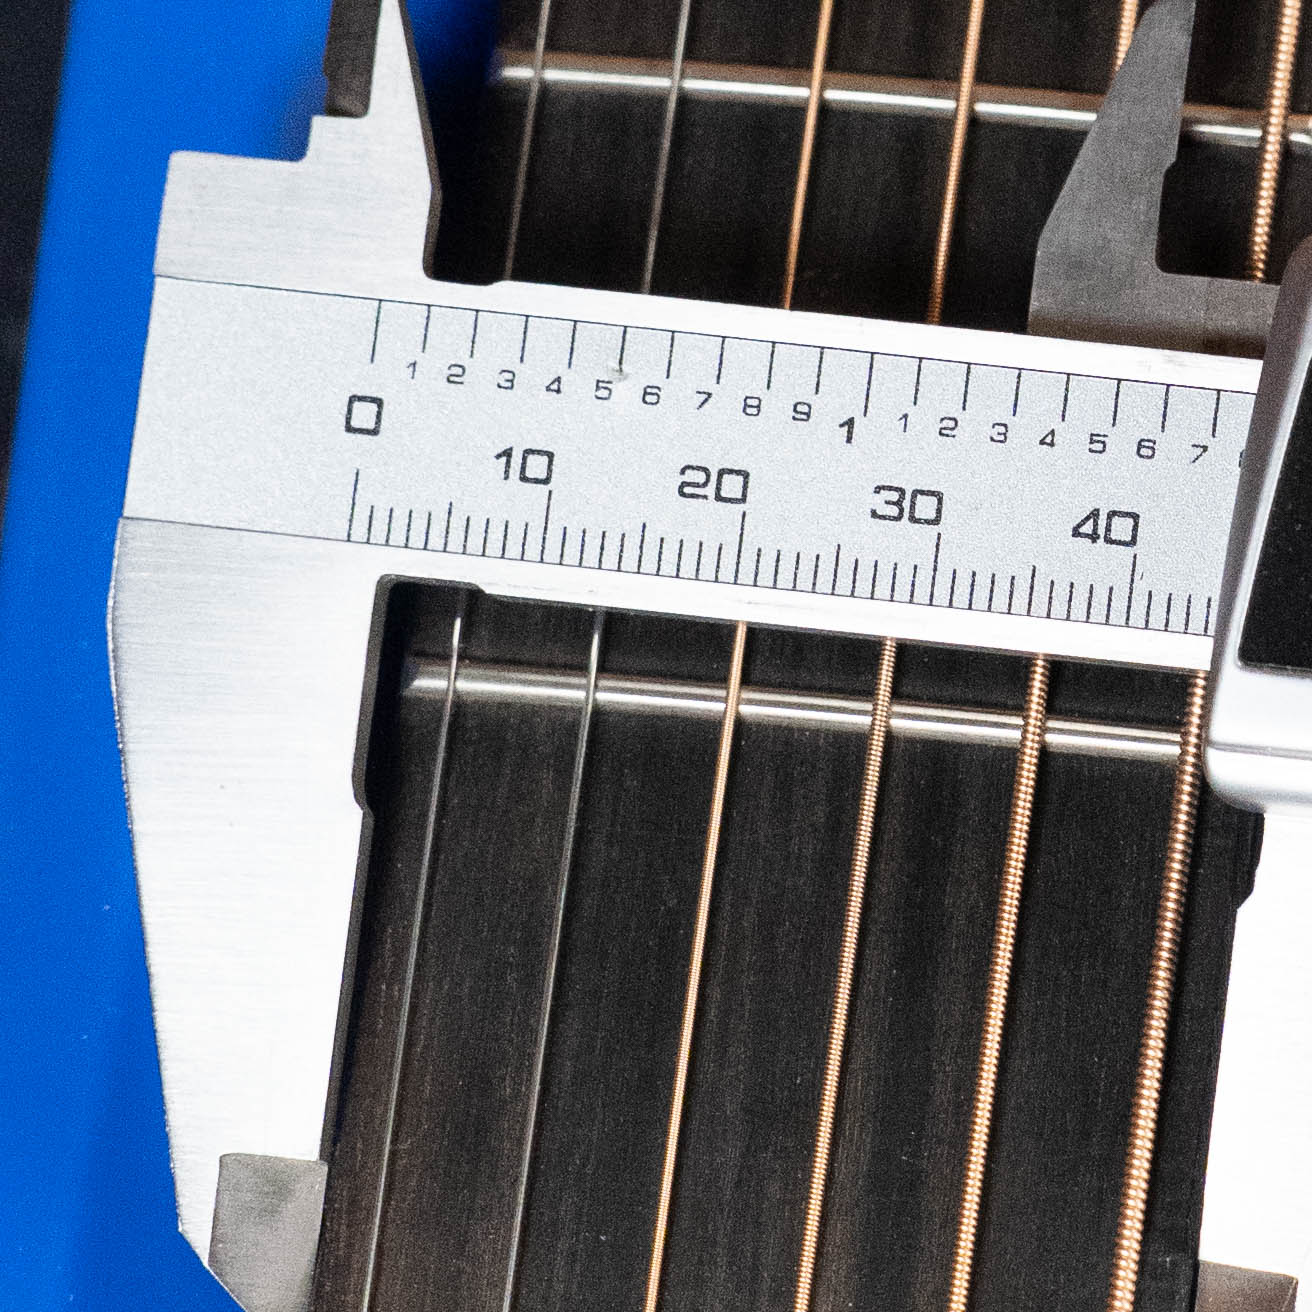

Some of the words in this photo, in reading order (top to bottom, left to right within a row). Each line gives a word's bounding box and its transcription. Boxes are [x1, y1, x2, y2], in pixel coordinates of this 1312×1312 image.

[345, 395, 384, 436] 0
[495, 447, 554, 485] 10
[678, 465, 750, 504] 20
[871, 485, 943, 526] 30
[1072, 508, 1140, 547] 40
[407, 361, 417, 379] 1
[446, 364, 466, 385] 2
[497, 370, 516, 390] 3
[546, 376, 561, 394] 4
[595, 379, 613, 400] 5
[642, 385, 661, 405] 6
[696, 391, 712, 410] 7
[742, 396, 762, 416] 8
[792, 402, 812, 422] 9
[839, 417, 854, 444] 1
[899, 413, 908, 433] 1
[939, 417, 958, 438] 2
[990, 423, 1008, 443] 3
[1039, 429, 1055, 448] 4
[1089, 433, 1108, 454] 5
[1136, 438, 1156, 459] 6
[1192, 444, 1208, 463] 7
